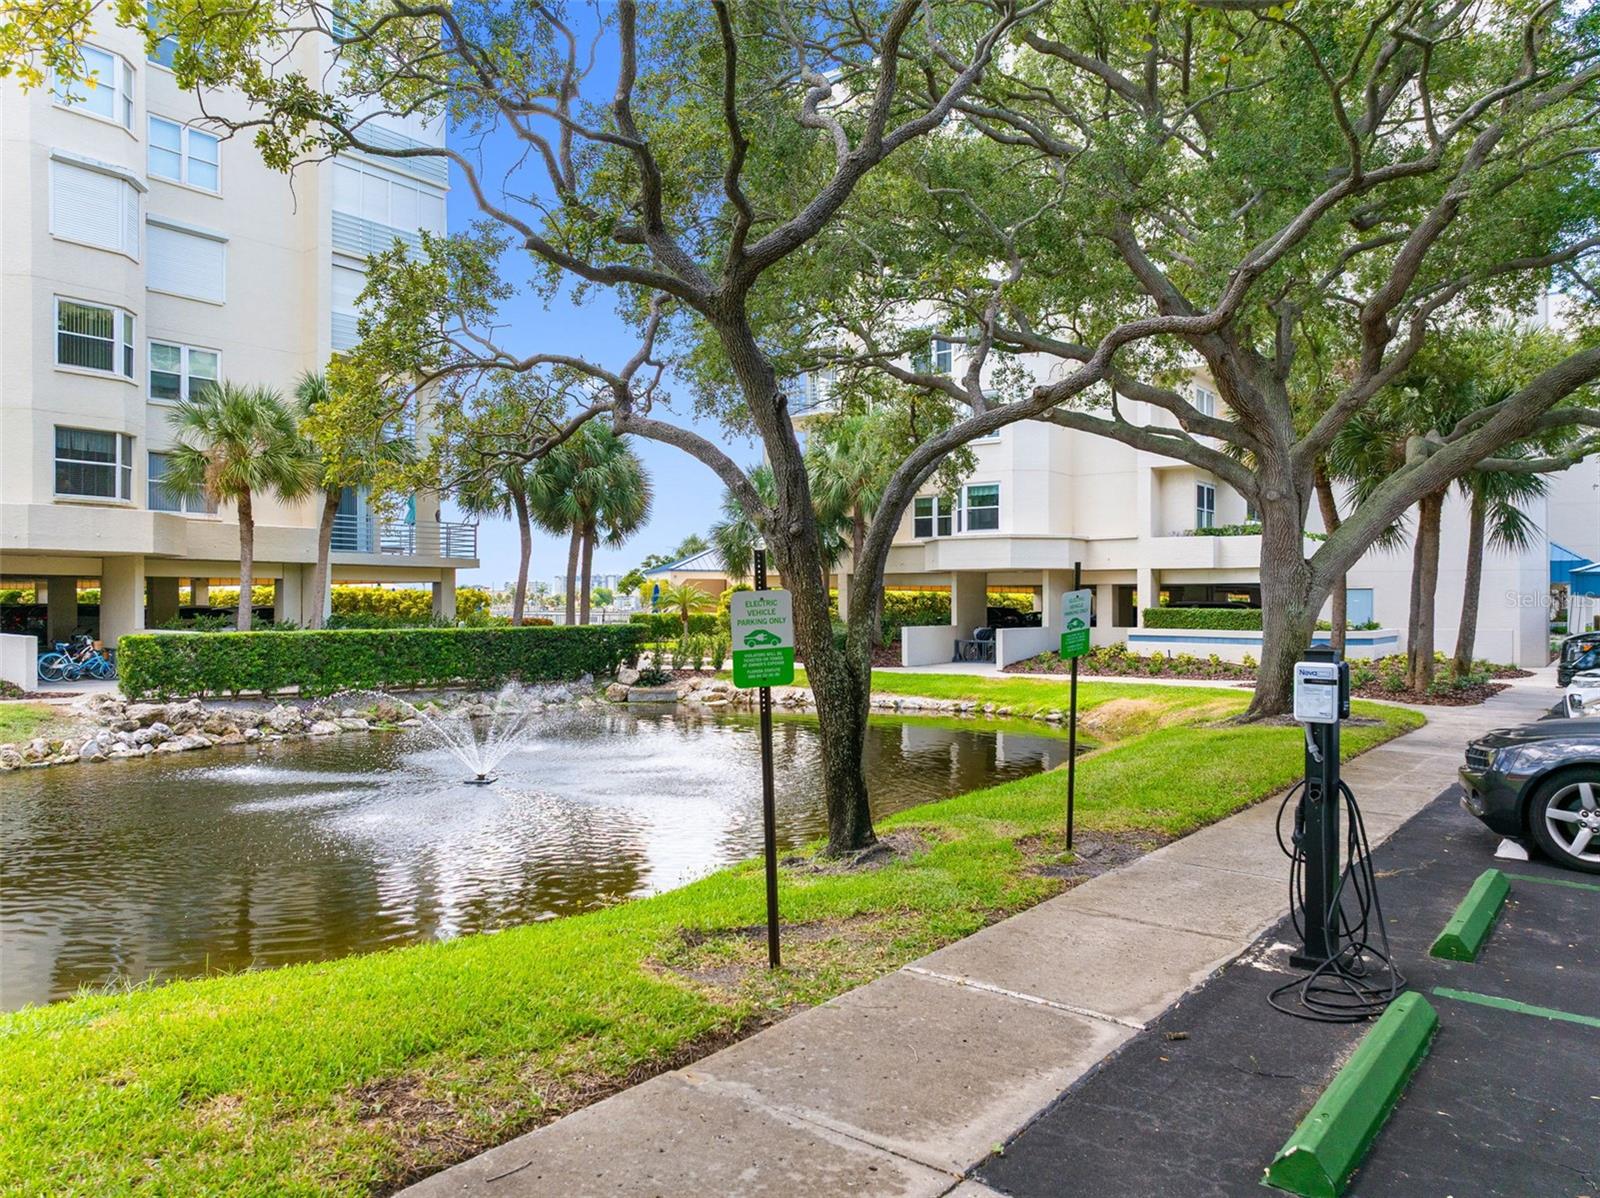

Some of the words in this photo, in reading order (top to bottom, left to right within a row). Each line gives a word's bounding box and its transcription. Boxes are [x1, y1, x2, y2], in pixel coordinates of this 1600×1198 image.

[745, 599, 778, 608] ELECTRIC
[747, 607, 776, 616] VEHICLE
[737, 618, 768, 626] PARKING
[768, 616, 786, 624] ONLY
